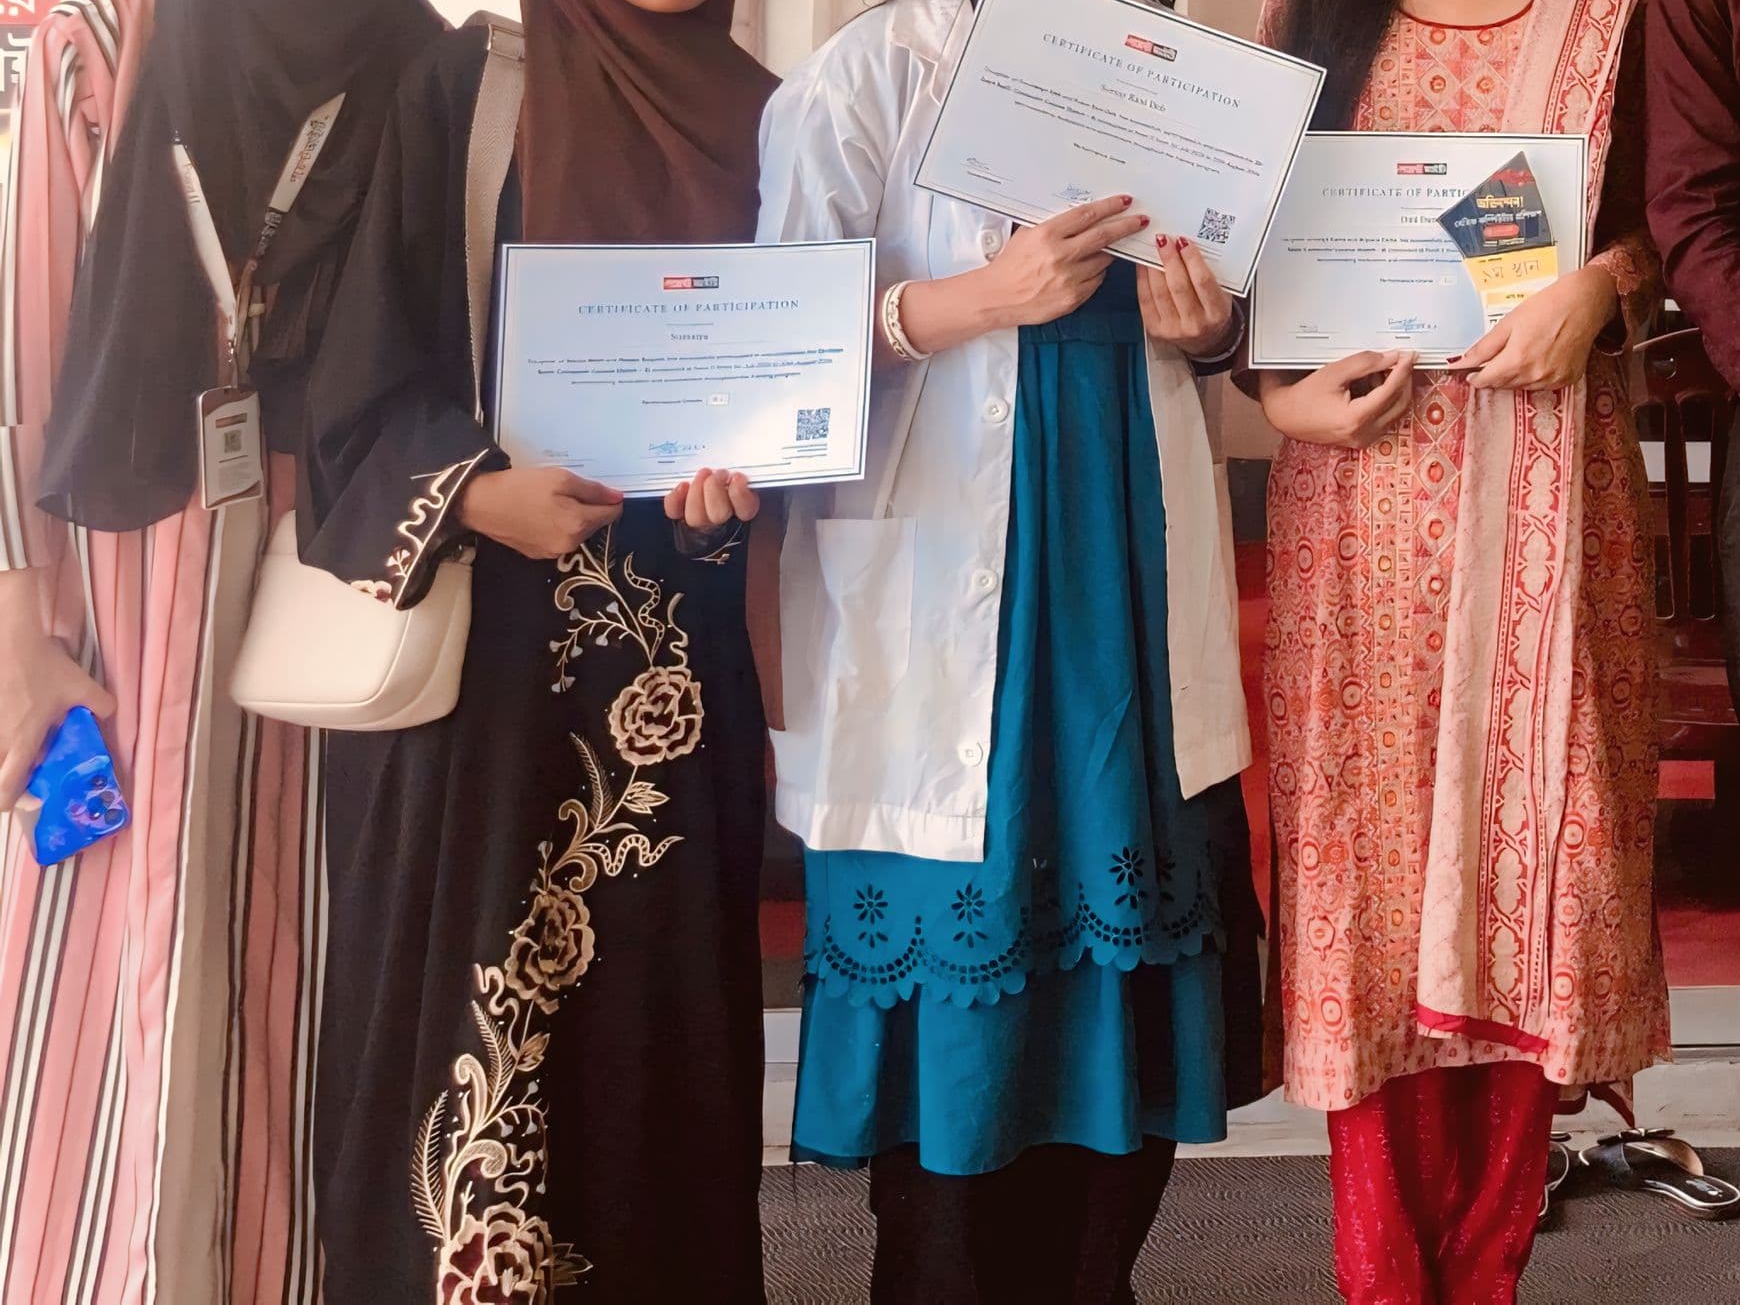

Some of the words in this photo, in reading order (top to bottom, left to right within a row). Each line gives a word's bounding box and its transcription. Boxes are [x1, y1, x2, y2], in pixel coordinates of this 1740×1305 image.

[1043, 33, 1124, 68] CERTIFICATE
[1127, 62, 1144, 75] OF
[1148, 70, 1241, 108] PARTICIPATION
[1322, 188, 1402, 198] CERTIFICATE
[1406, 188, 1422, 198] OF
[578, 304, 667, 314] CERTIFICATE
[673, 303, 688, 312] OF
[696, 300, 799, 312] PARTICIPATION
